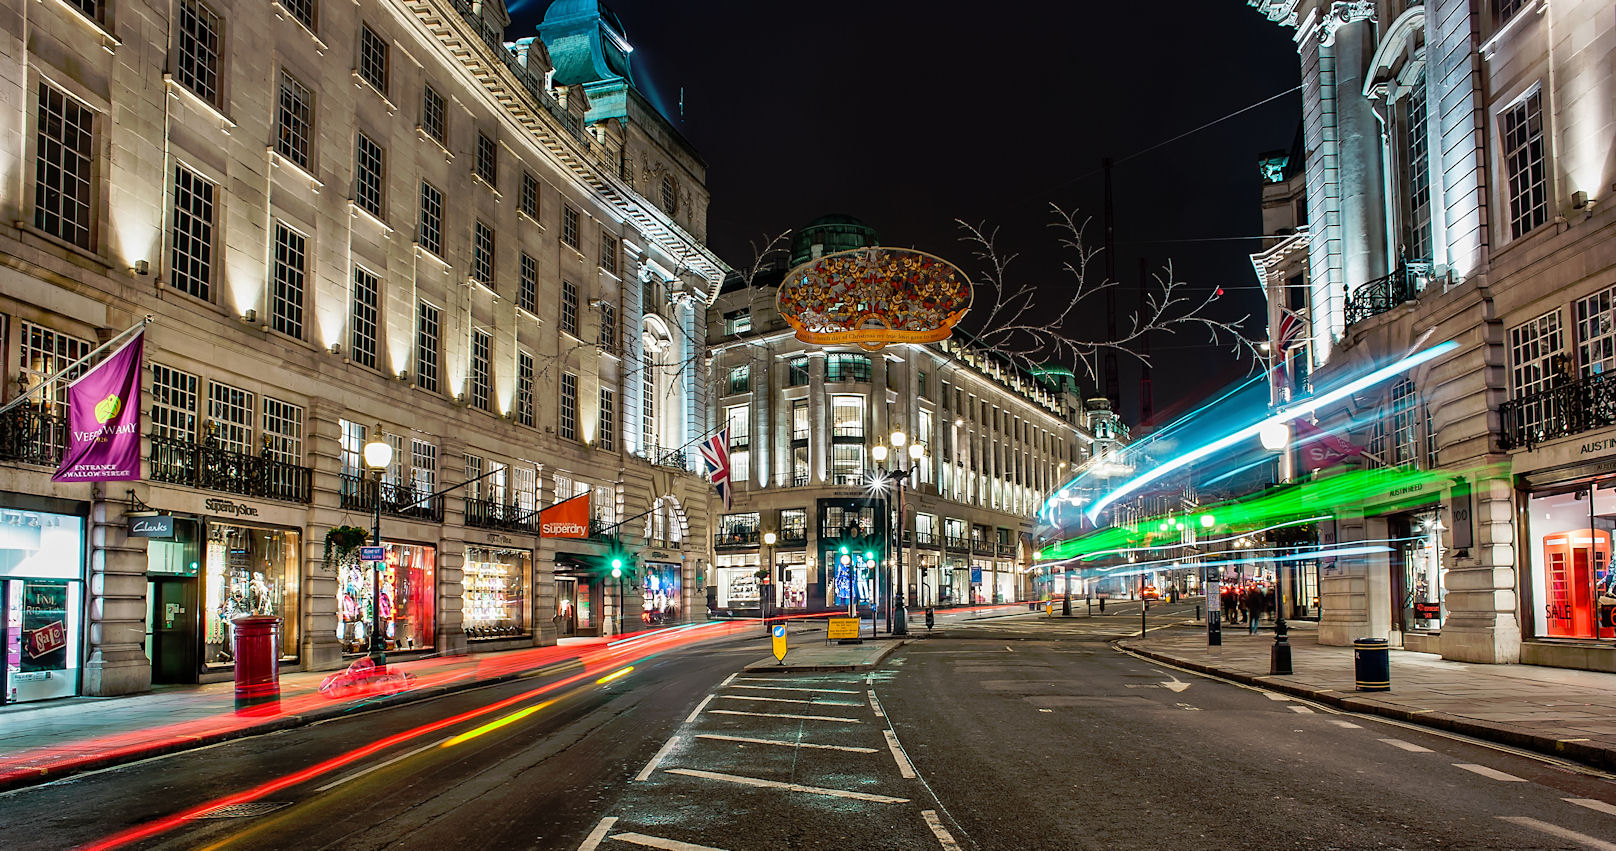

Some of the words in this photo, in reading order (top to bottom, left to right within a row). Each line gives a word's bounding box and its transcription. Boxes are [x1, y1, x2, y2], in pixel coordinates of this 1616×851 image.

[62, 470, 100, 478] SWALLOW
[1453, 509, 1468, 523] 100
[132, 520, 168, 533] Clarks
[542, 522, 587, 537] Superdry
[1545, 604, 1572, 620] SALE
